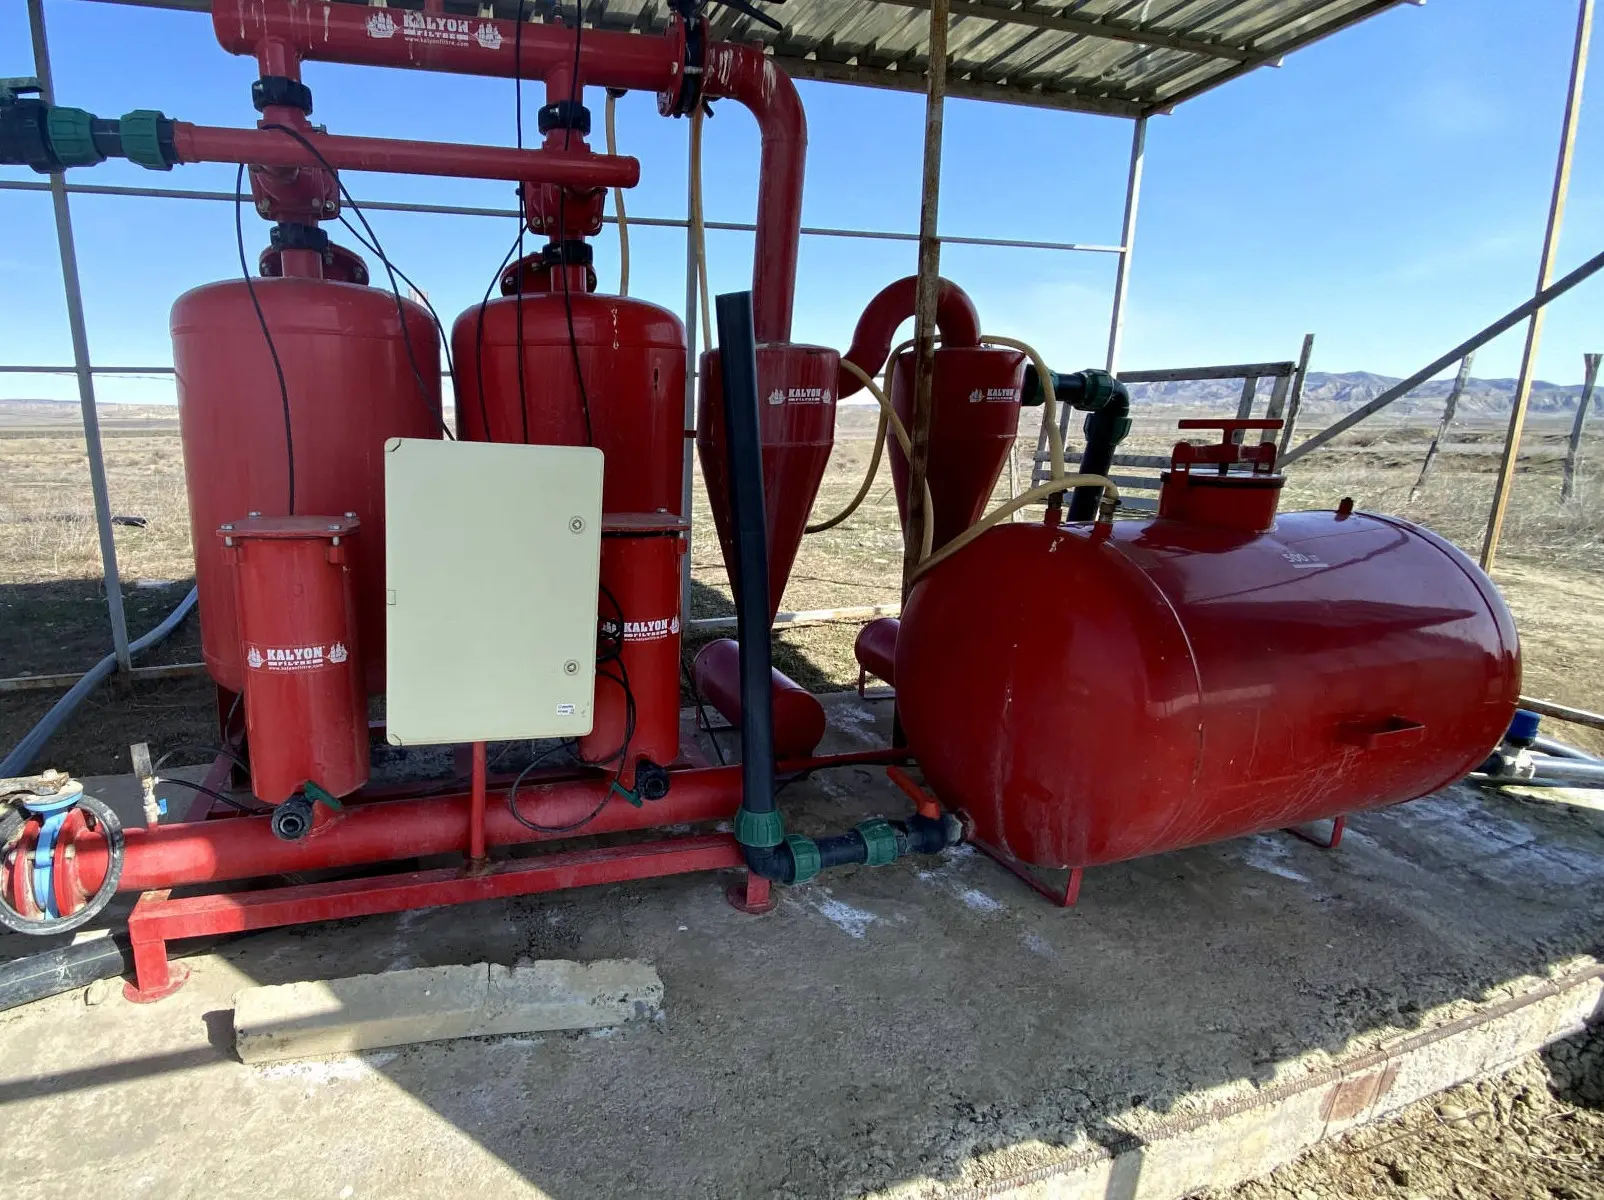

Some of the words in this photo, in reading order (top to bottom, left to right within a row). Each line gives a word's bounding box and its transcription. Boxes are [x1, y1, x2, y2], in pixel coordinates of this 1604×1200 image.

[404, 13, 469, 33] KALYON
[788, 388, 821, 397] KALYON
[623, 619, 668, 633] KALYON
[267, 646, 323, 661] KALYON
